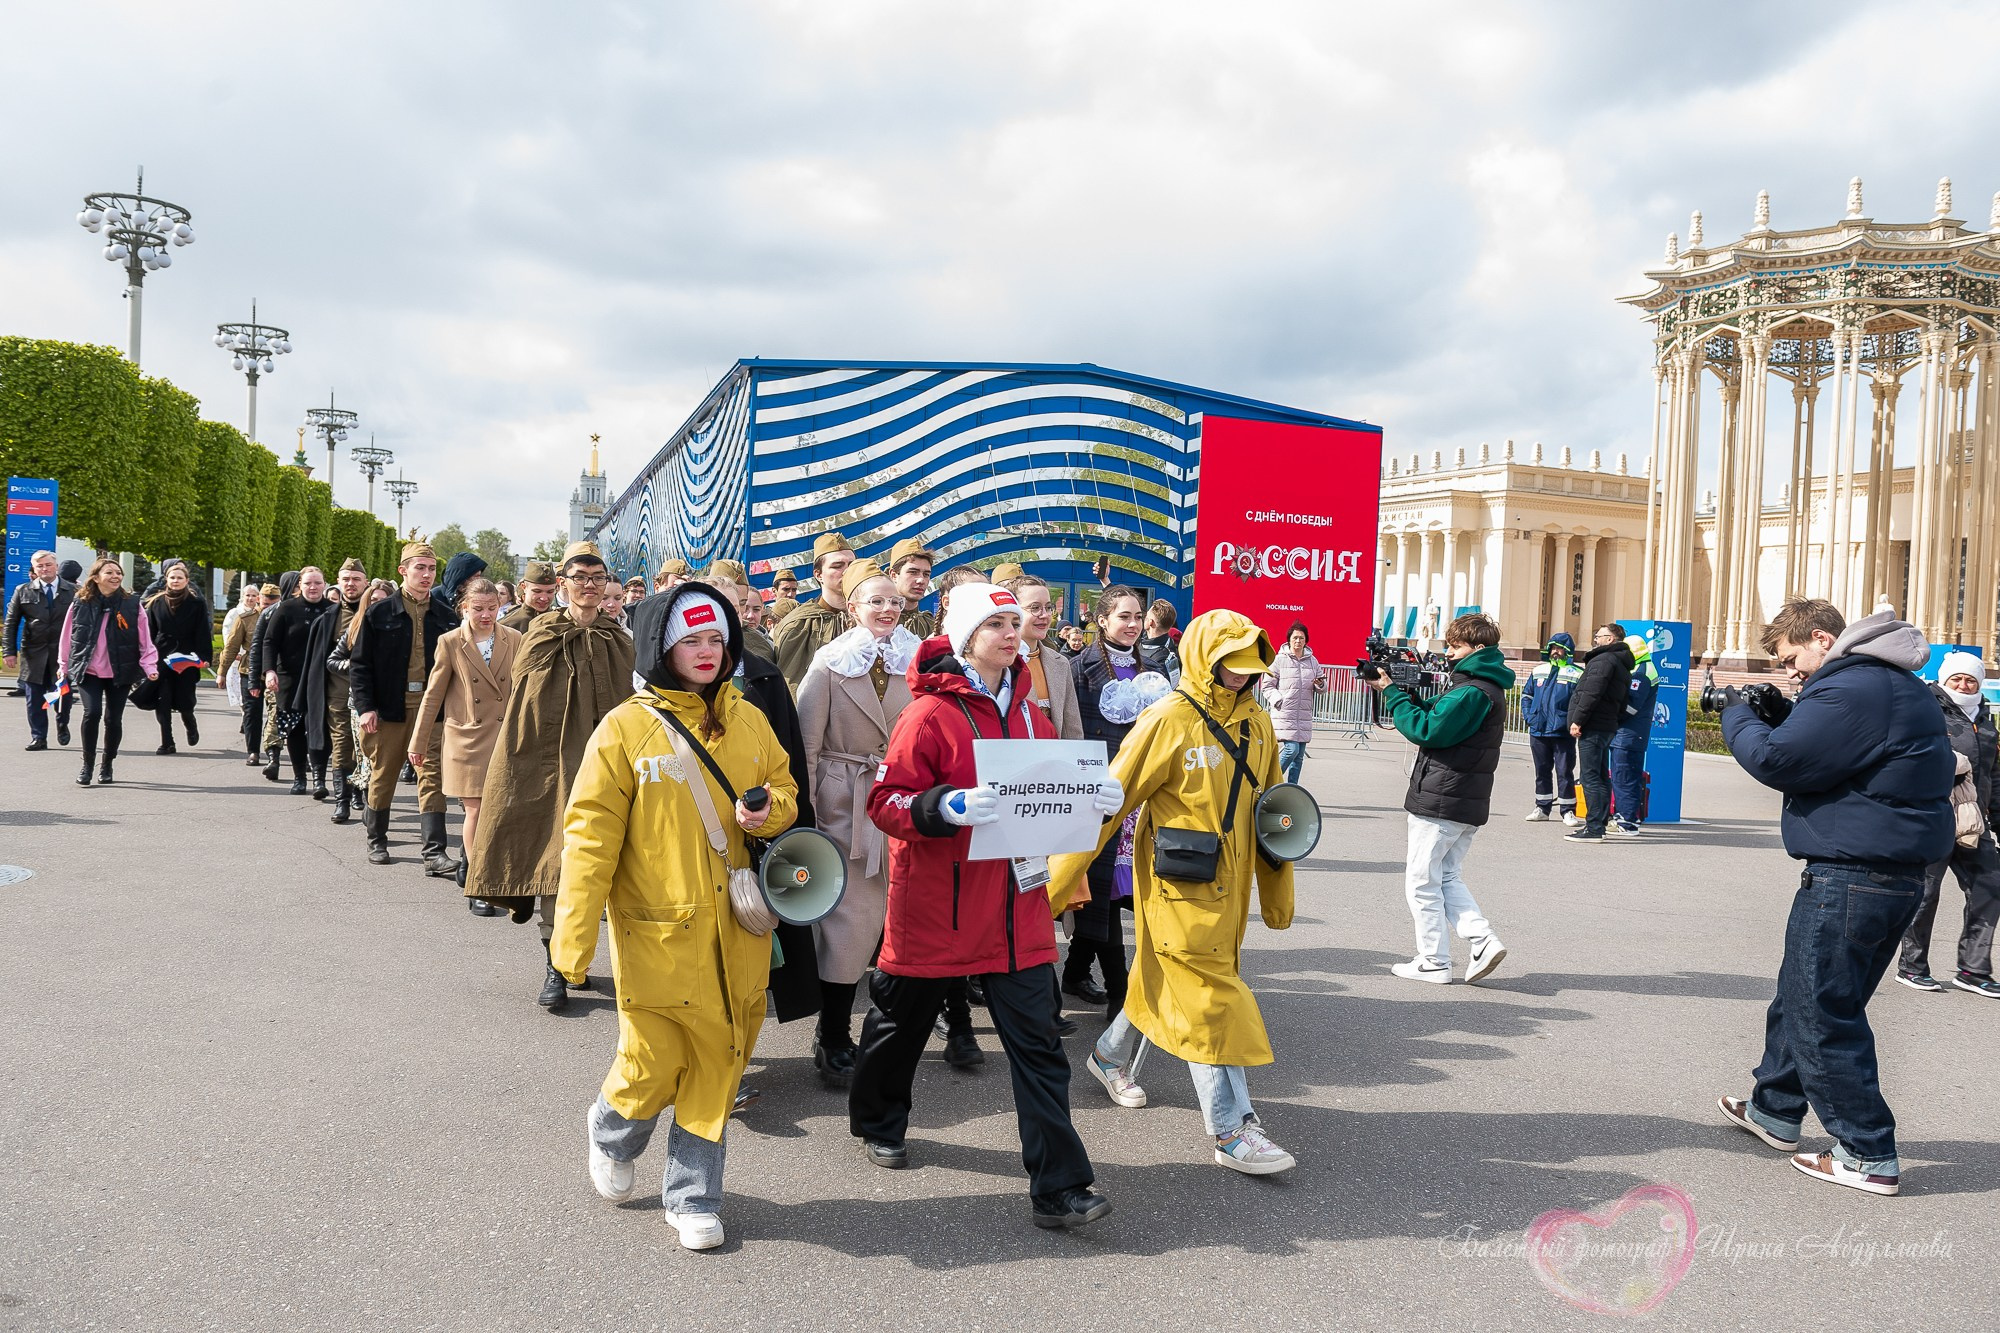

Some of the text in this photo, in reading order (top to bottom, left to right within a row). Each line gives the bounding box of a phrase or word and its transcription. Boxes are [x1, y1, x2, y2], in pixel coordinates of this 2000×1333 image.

[10, 503, 17, 511] F
[1245, 510, 1333, 528] С ДНЁМ ПОБЕДЫ!
[1210, 541, 1363, 584] РОССИЯ
[987, 781, 1104, 797] Танцевальная
[1014, 802, 1073, 818] группа
